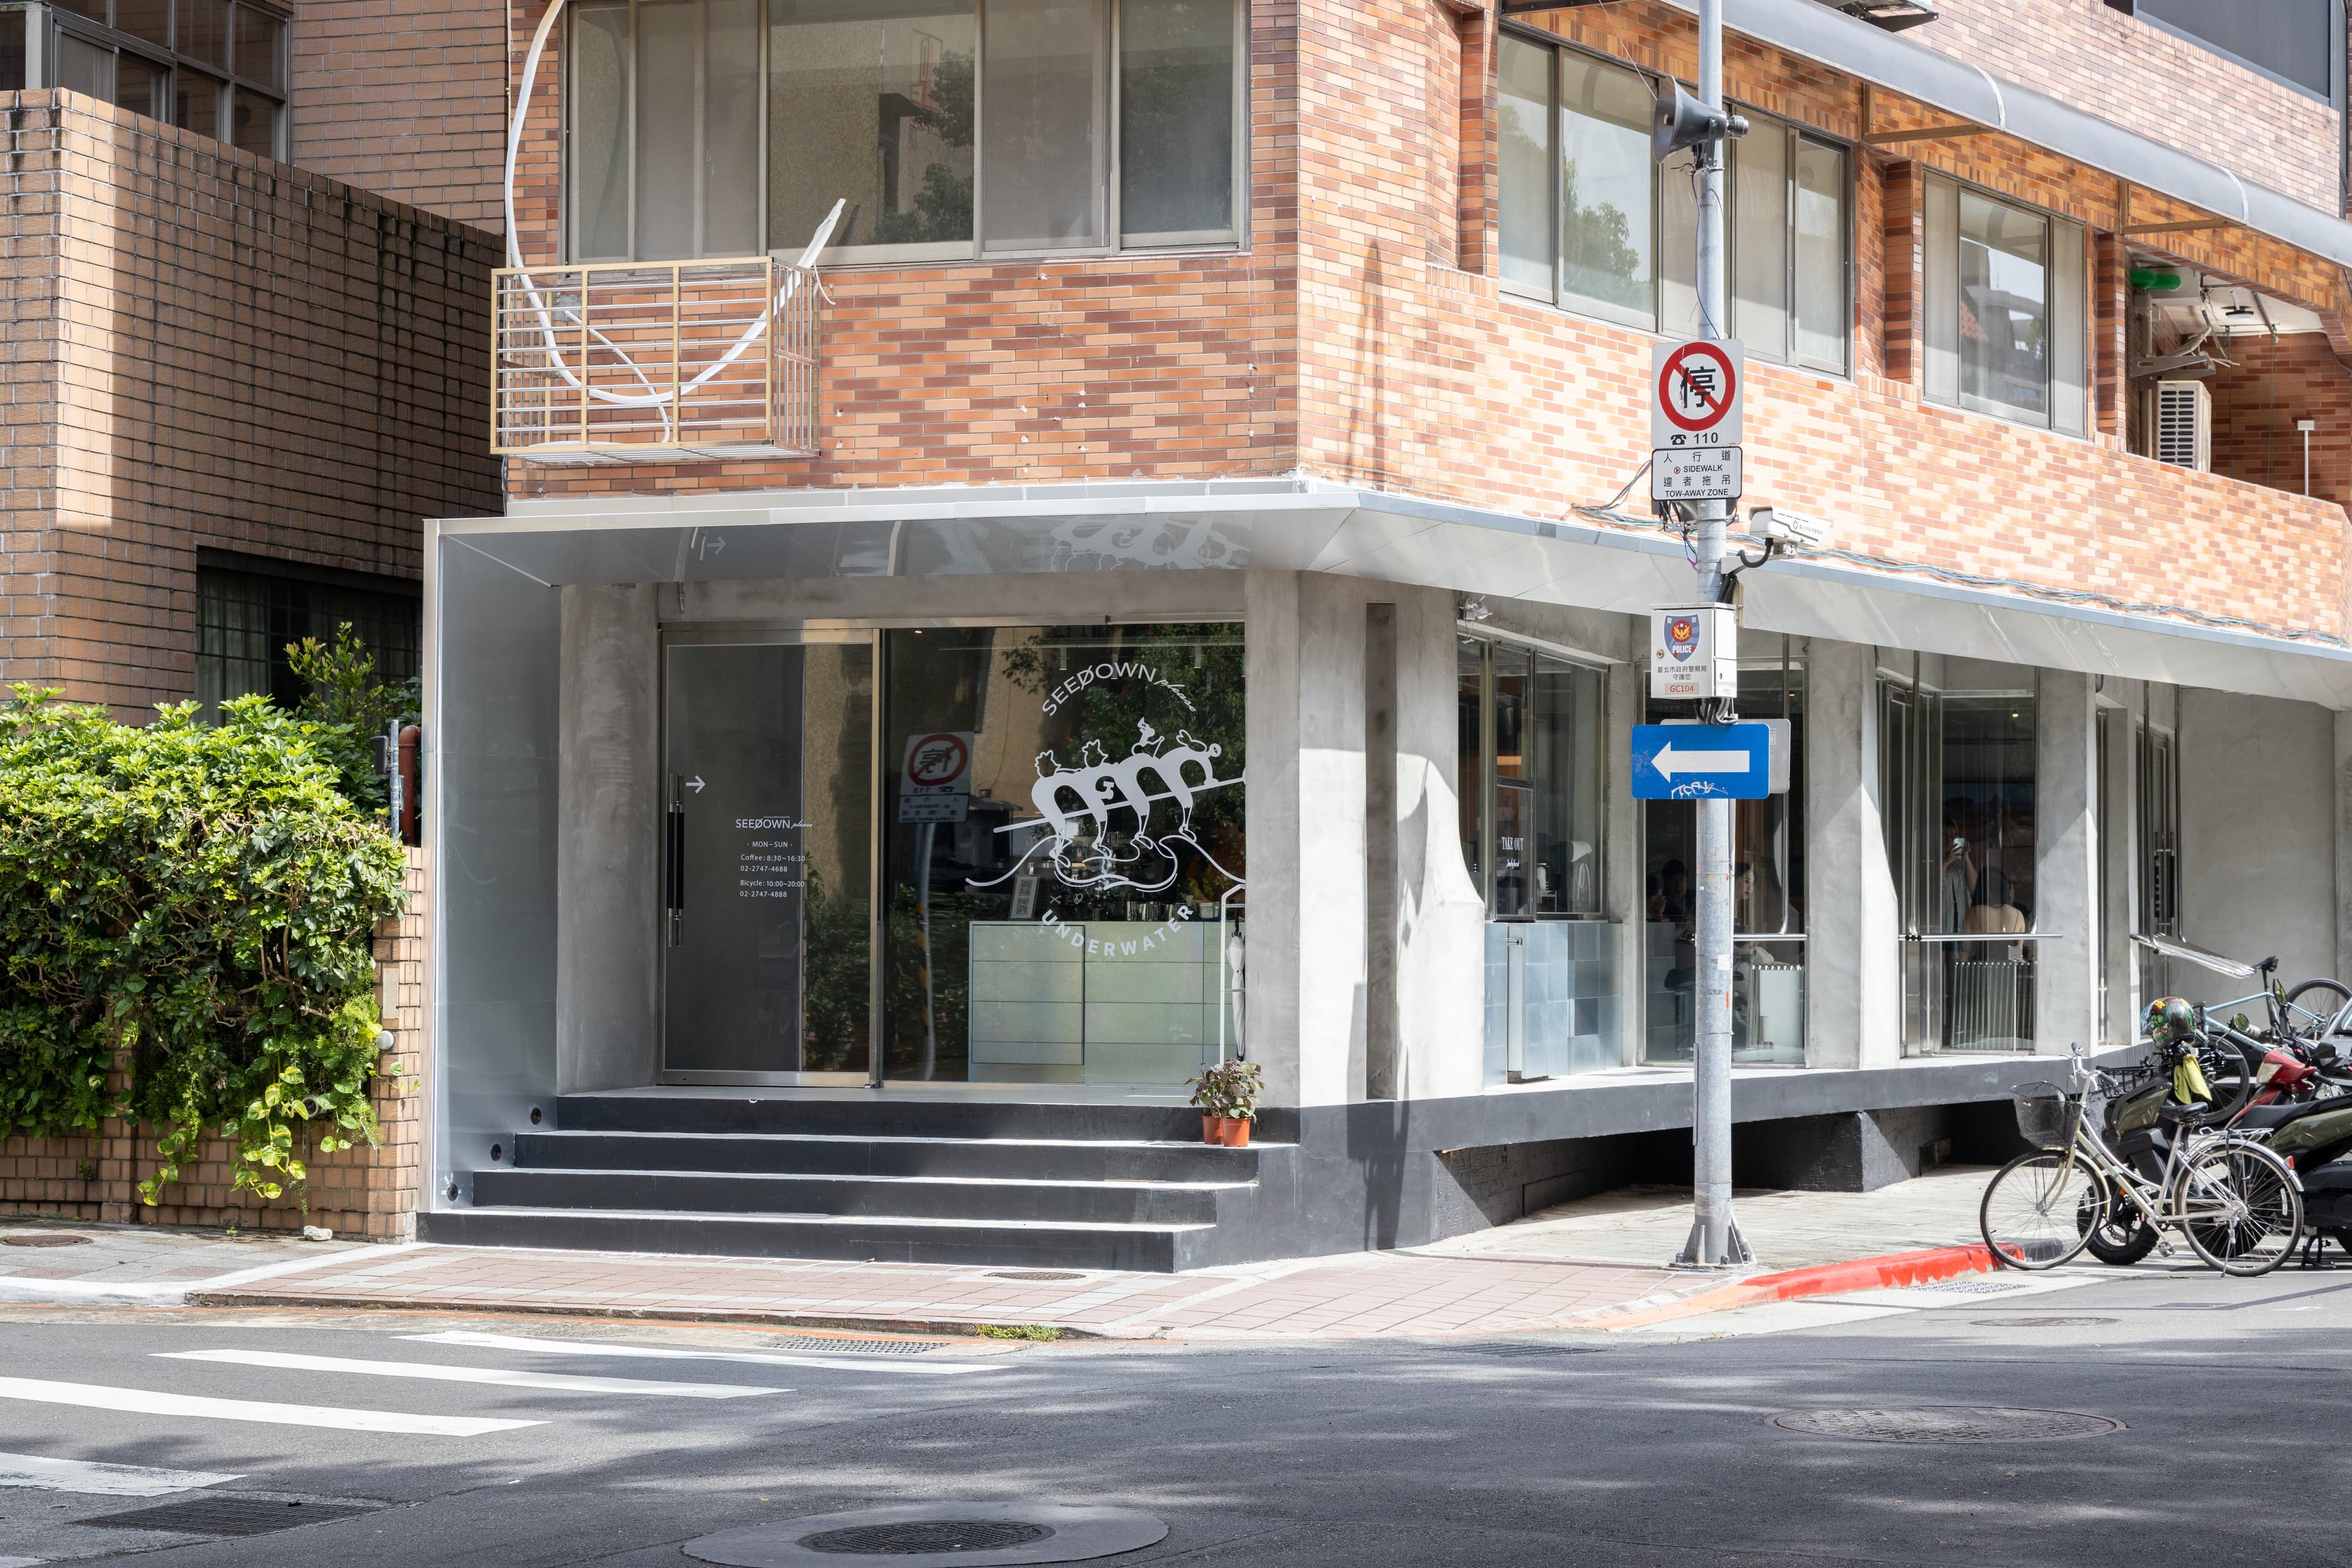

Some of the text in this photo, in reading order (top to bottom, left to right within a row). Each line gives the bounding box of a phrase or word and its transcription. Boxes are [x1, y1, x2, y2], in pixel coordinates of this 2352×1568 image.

[1680, 366, 1716, 409] 停
[1694, 432, 1719, 444] 110
[1663, 450, 1731, 463] 人行道
[1663, 475, 1731, 488] 違者拖吊
[1672, 645, 1692, 654] POLICE
[1154, 679, 1196, 713] please
[790, 819, 813, 830] please
[1501, 837, 1524, 851] TAKE OUT
[1041, 905, 1194, 957] UNDERWATER
